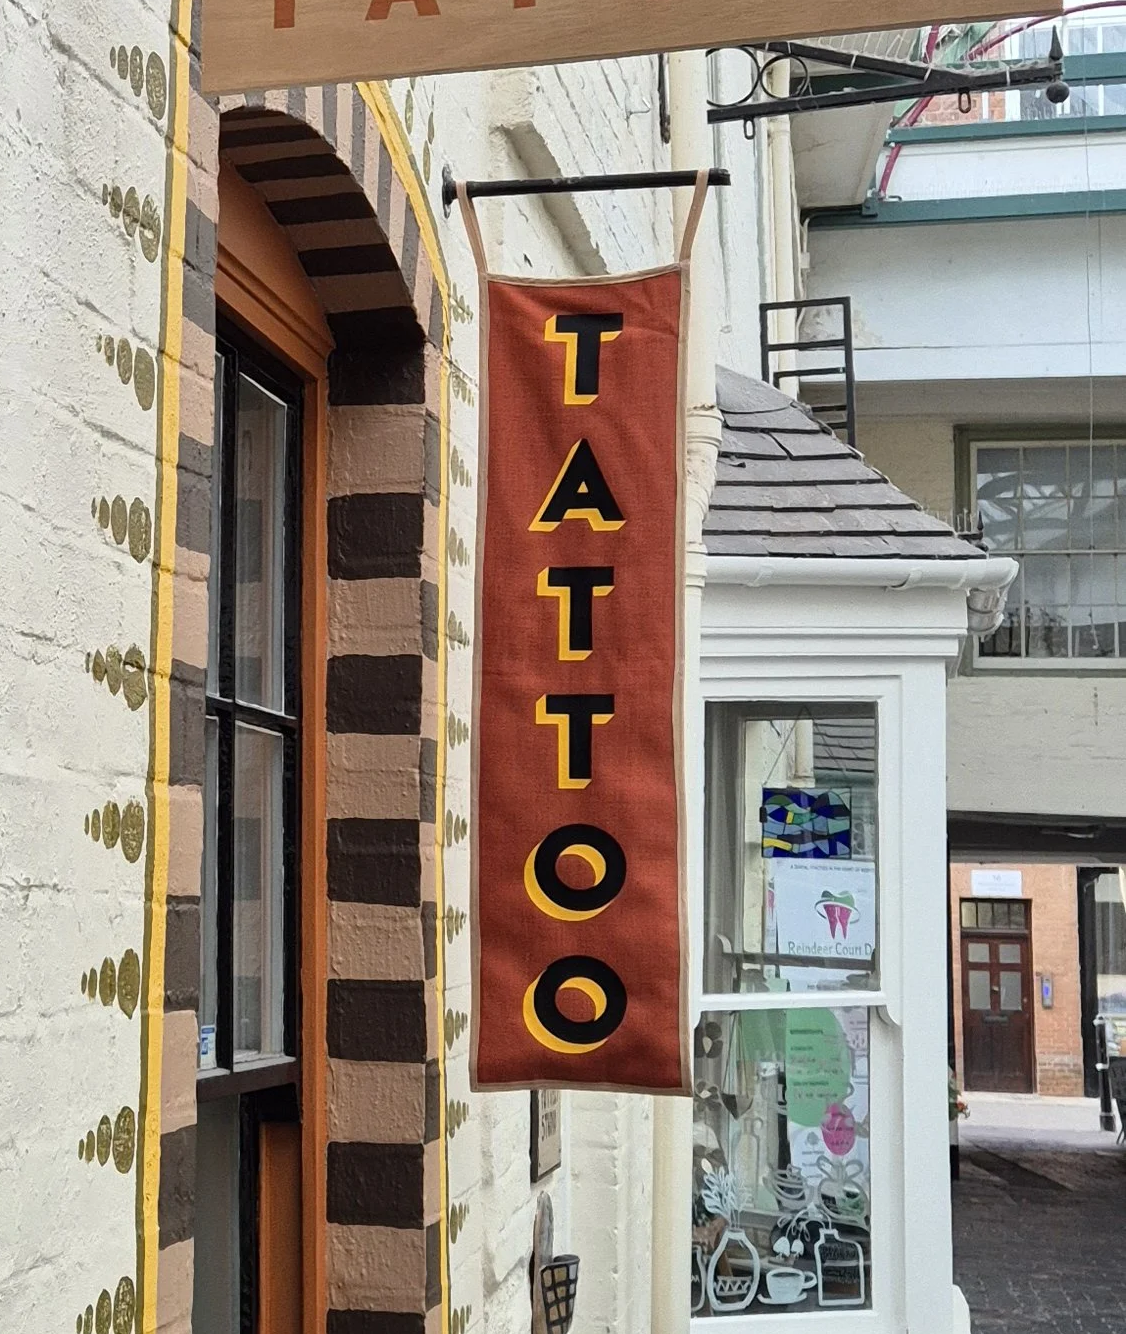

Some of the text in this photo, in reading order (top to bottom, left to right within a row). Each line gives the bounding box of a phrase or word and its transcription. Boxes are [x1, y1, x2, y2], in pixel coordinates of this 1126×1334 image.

[523, 311, 627, 1054] TATTOO
[788, 941, 833, 956] Reindeer
[835, 942, 862, 956] Court
